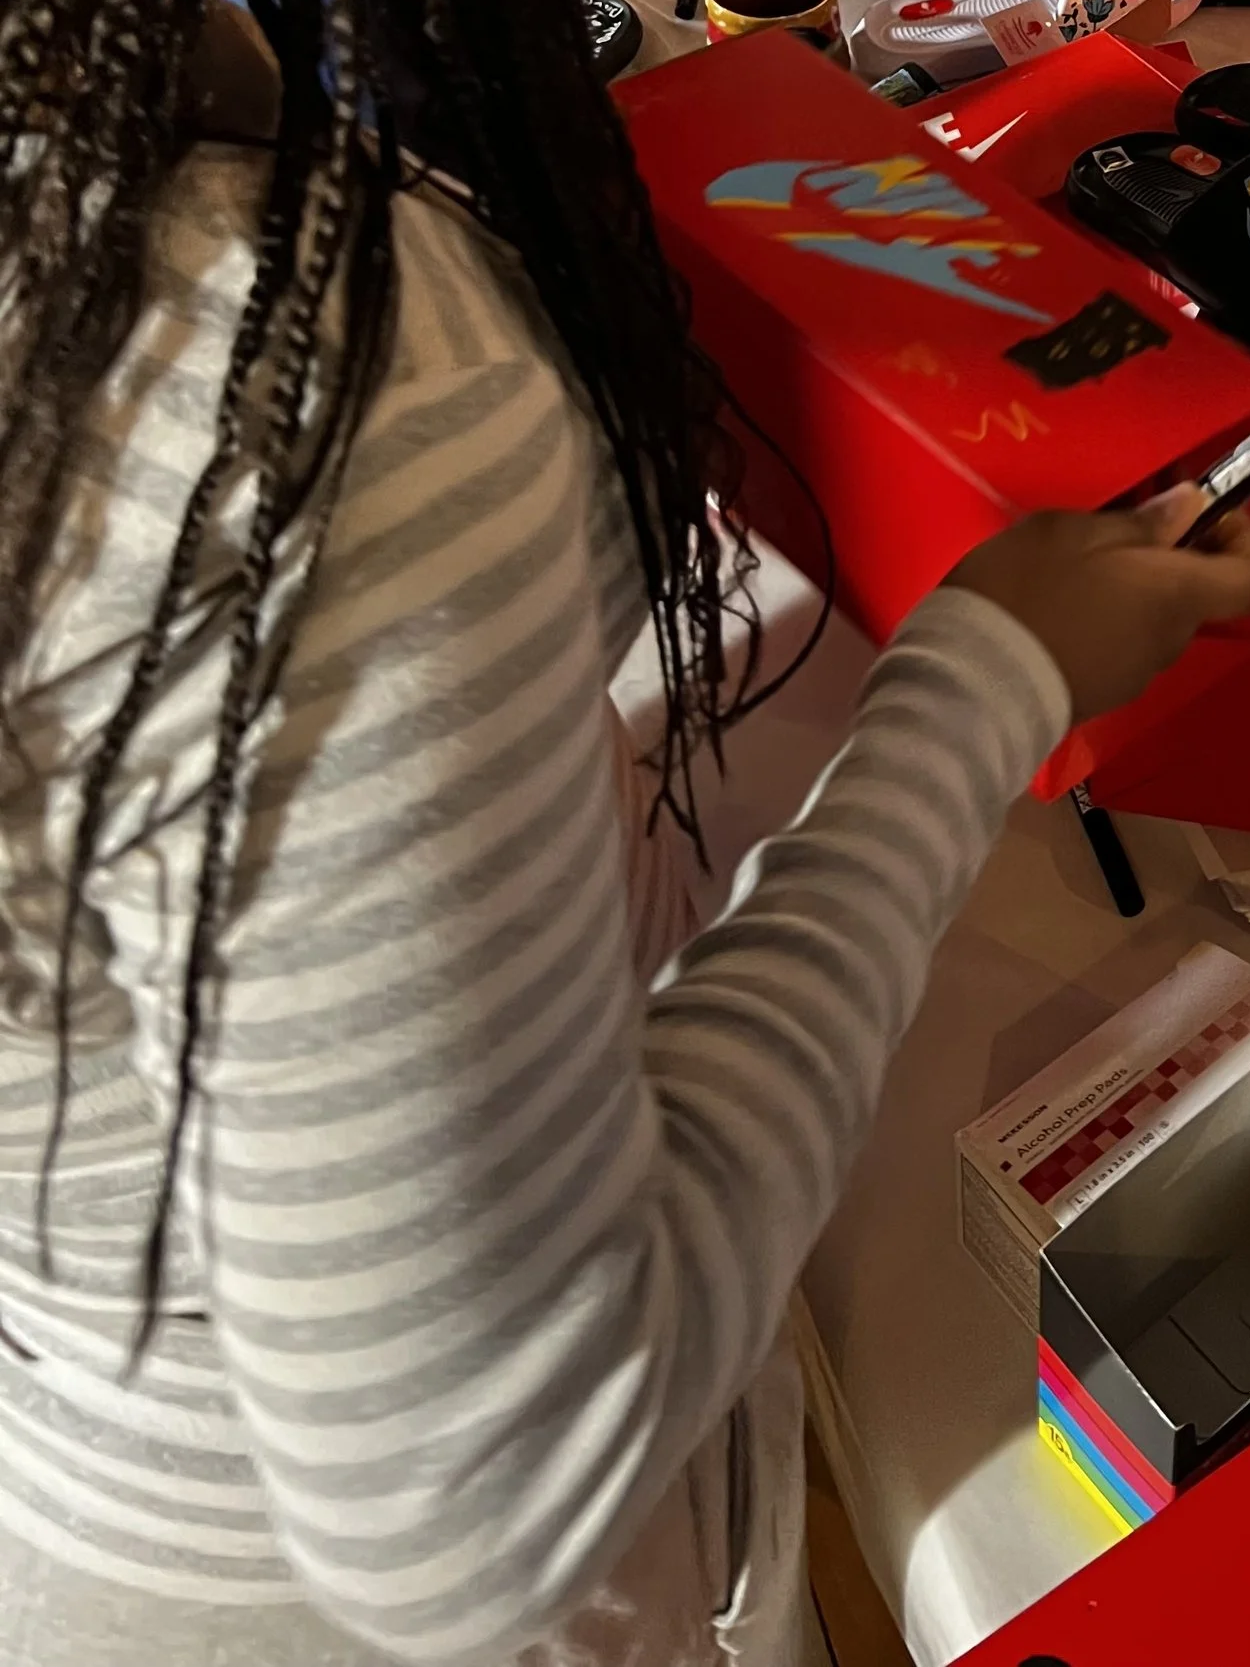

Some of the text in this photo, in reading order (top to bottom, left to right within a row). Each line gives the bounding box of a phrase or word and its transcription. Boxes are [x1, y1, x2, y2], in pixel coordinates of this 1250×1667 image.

[1016, 1066, 1130, 1159] Alcohol Prep Pads
[1074, 1193, 1086, 1207] L
[1113, 1153, 1128, 1172] 3.5
[1139, 1130, 1156, 1148] 100
